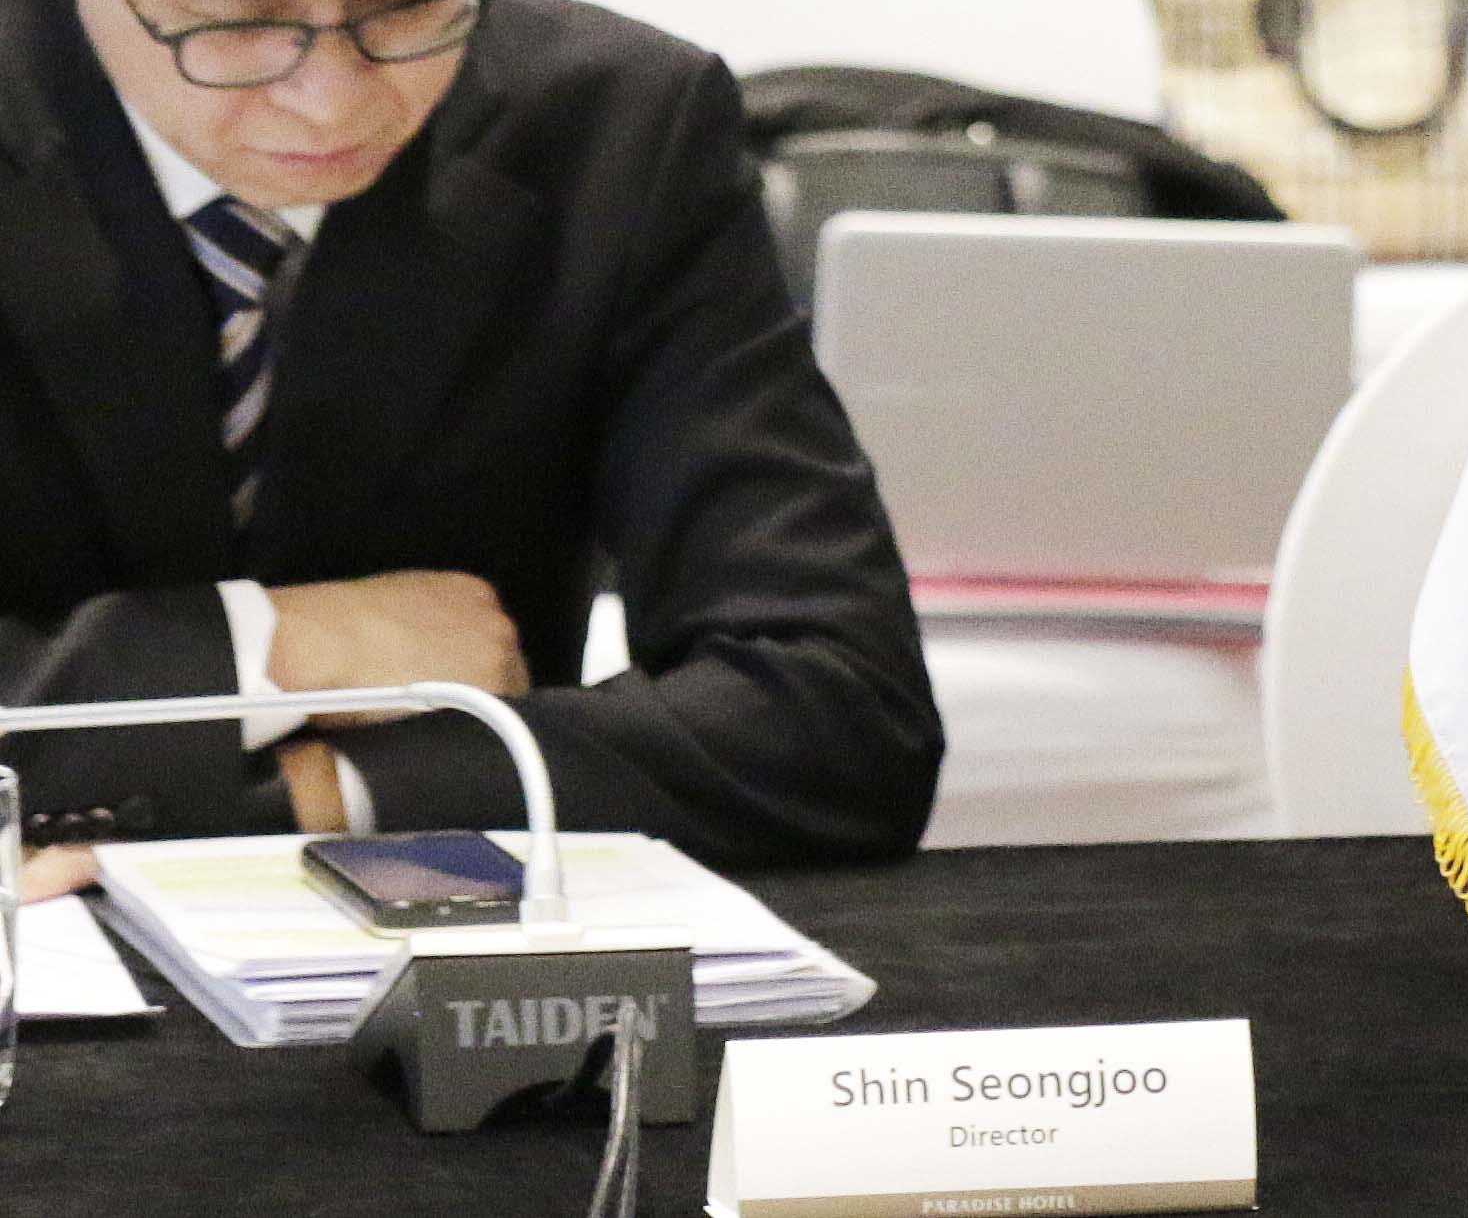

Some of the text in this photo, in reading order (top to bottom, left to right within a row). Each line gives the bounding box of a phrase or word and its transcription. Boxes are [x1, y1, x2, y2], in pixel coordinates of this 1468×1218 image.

[832, 1058, 1168, 1109] Shin Seongjoo
[950, 1124, 1058, 1149] Director
[921, 1194, 1076, 1214] PARADISE HOTEL
